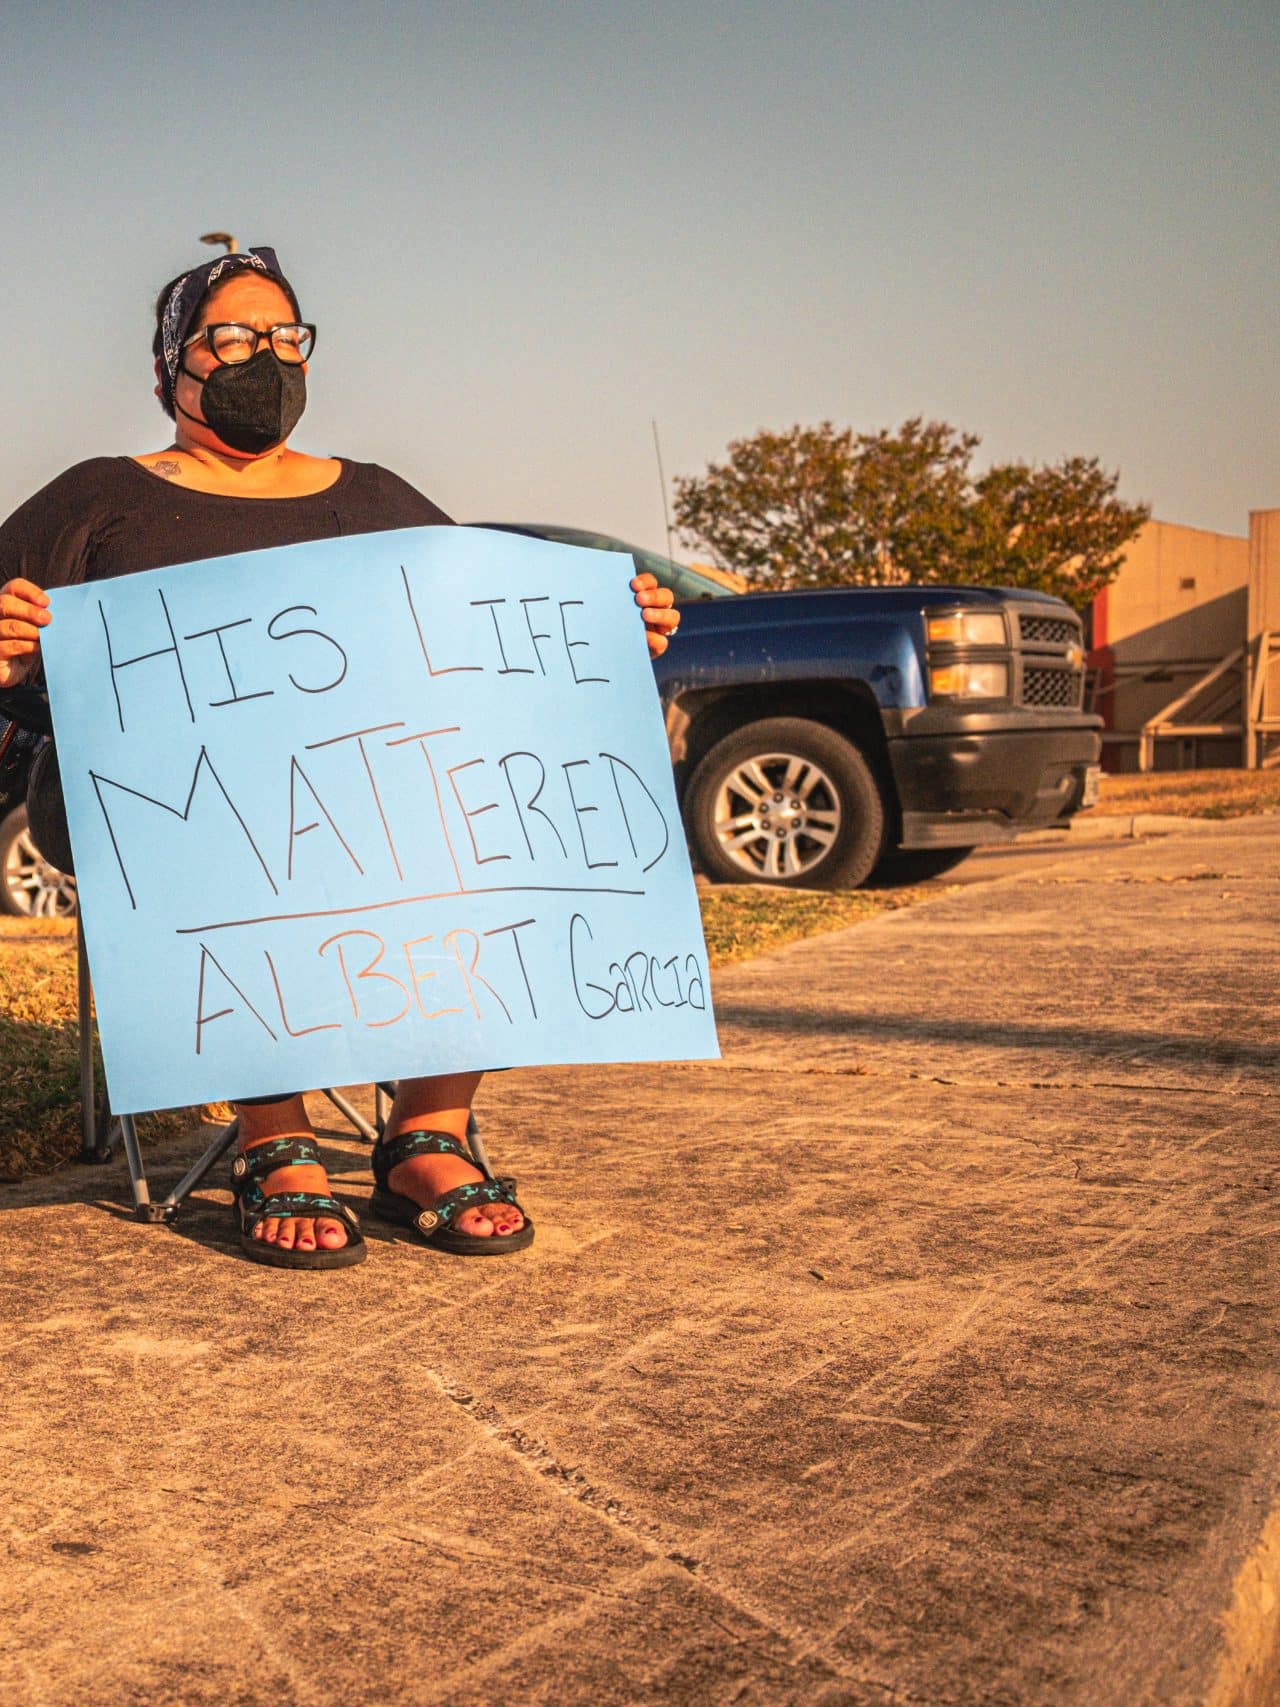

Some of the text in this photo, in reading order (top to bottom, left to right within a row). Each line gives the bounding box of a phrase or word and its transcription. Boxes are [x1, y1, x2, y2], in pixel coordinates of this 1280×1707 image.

[98, 564, 610, 733] HIS LIFE
[88, 721, 670, 910] MATTERED
[195, 917, 537, 1055] ALBERT
